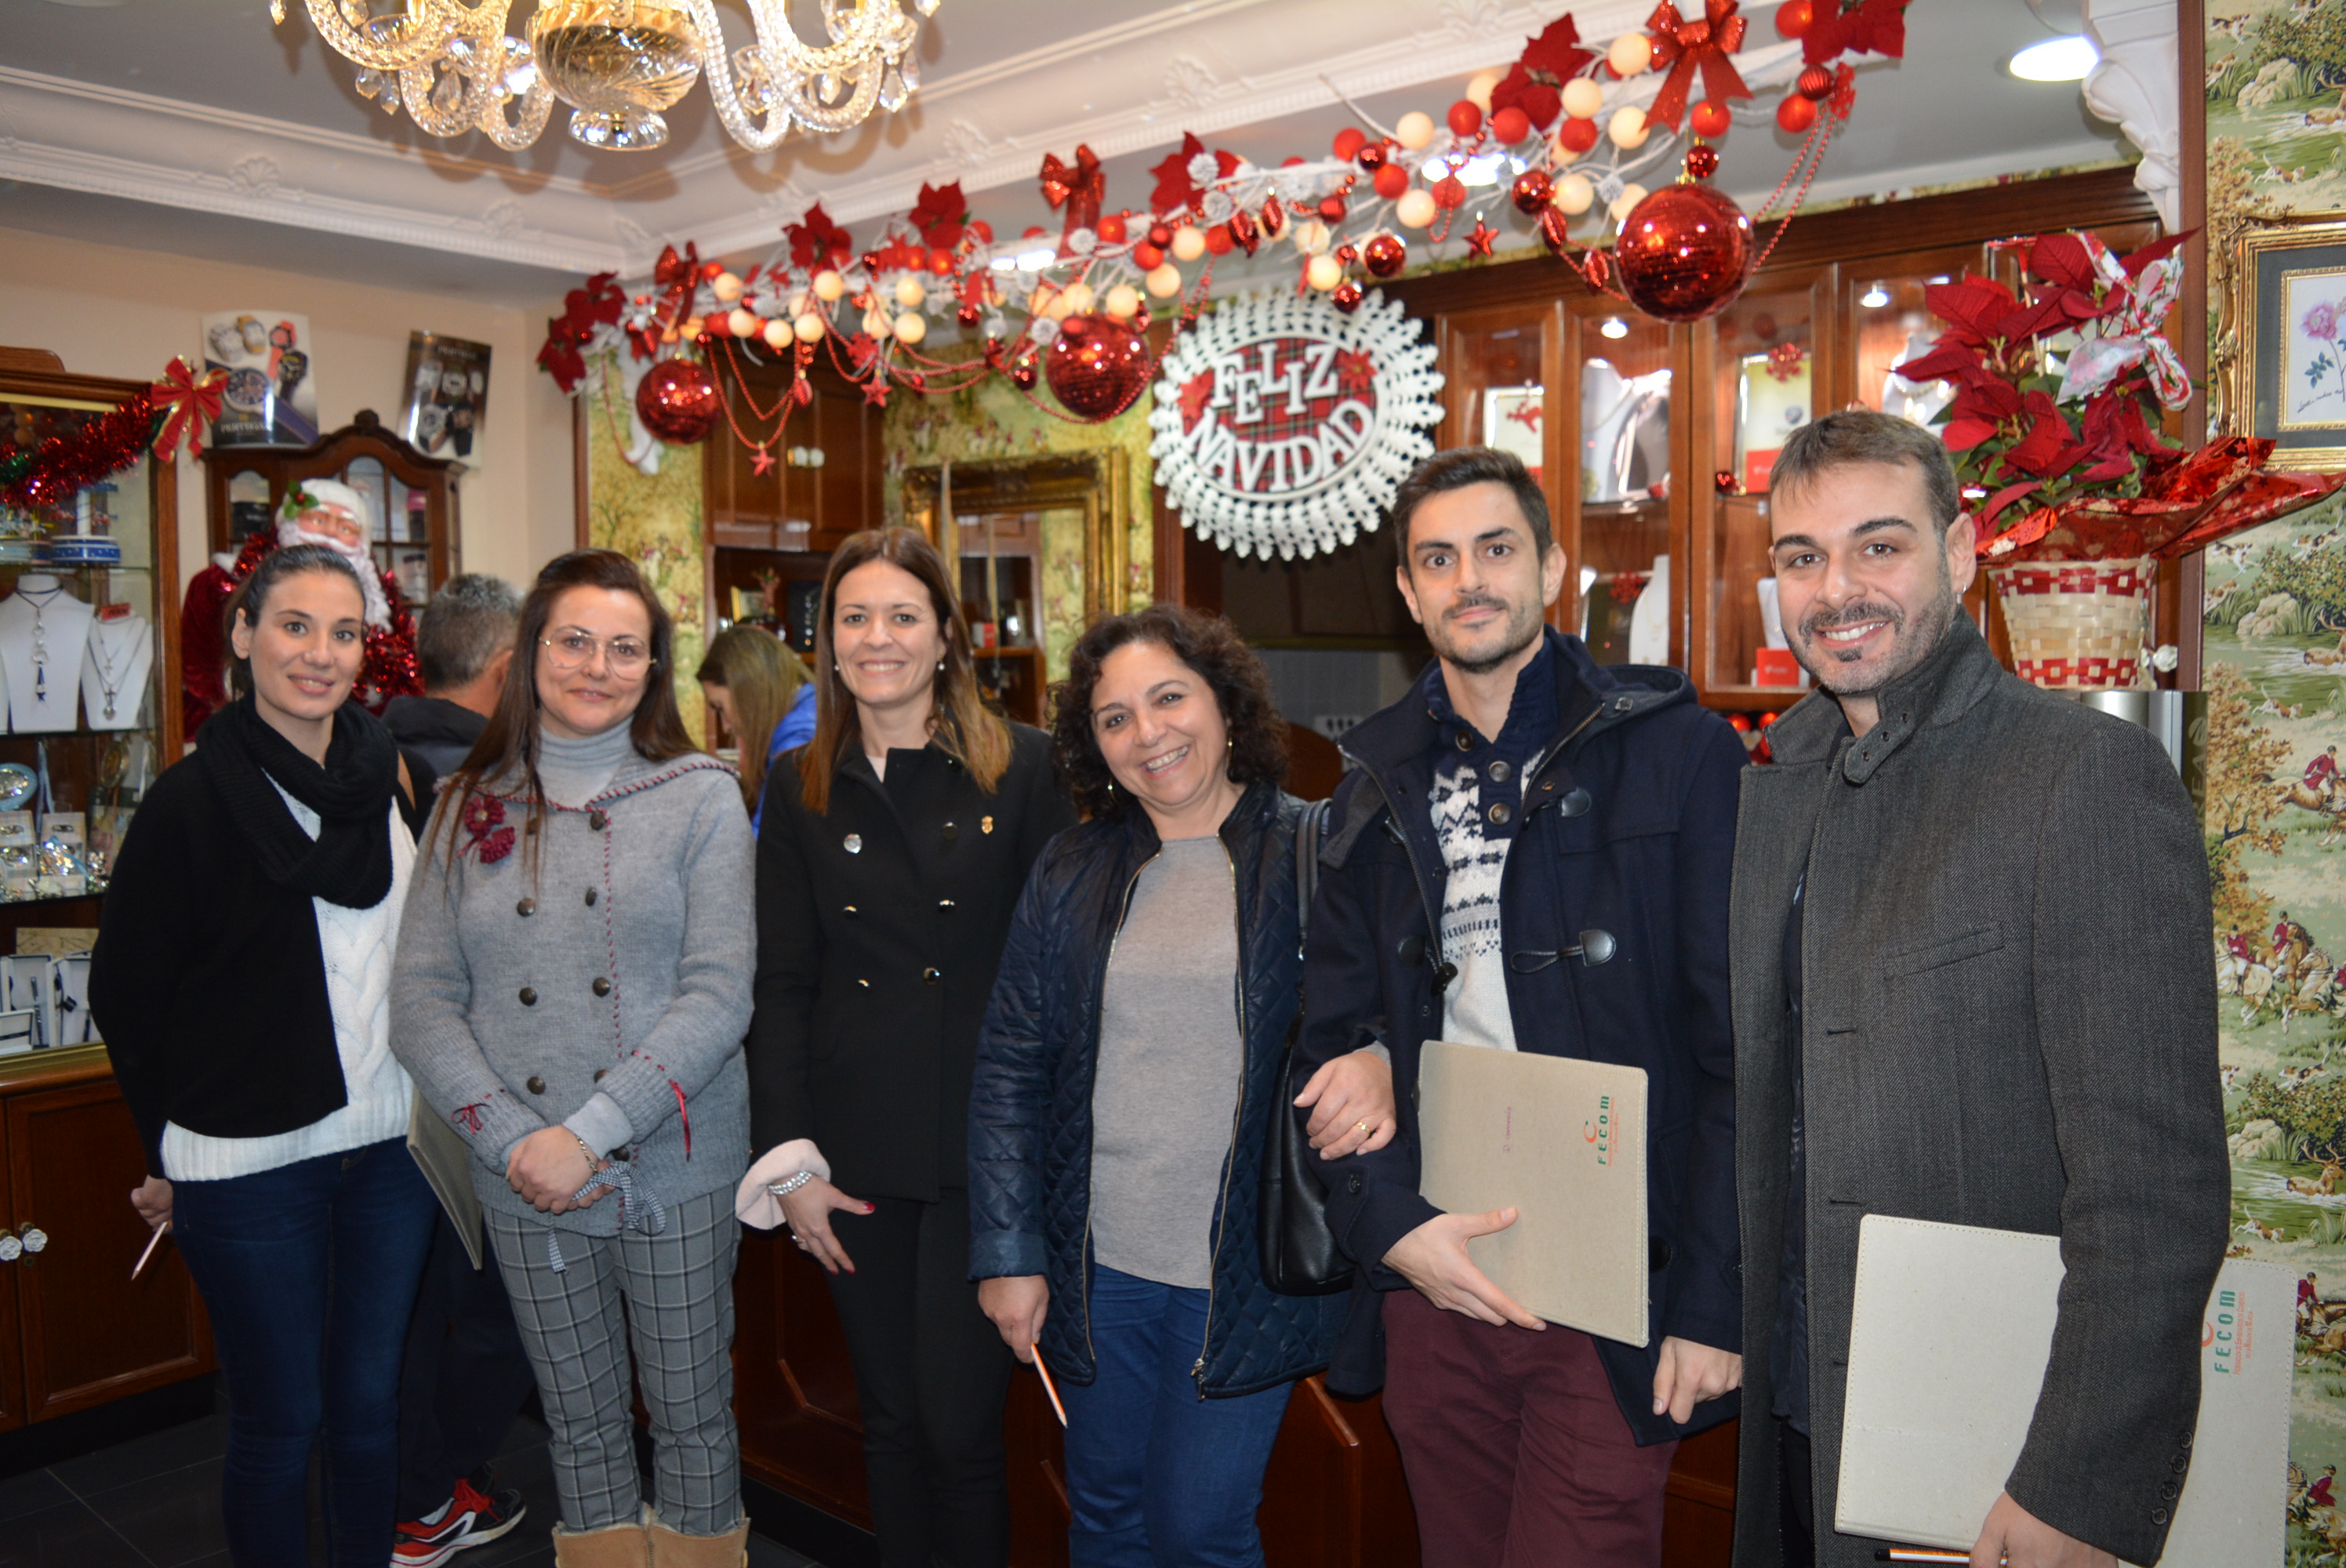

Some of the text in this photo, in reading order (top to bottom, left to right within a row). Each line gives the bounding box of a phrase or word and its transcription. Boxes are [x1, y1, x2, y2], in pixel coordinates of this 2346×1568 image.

[1210, 342, 1339, 424] FELIZ
[1184, 399, 1375, 492] NAVIDAD
[1597, 1095, 1610, 1165] FECOM
[2214, 1290, 2235, 1374] FECOM
